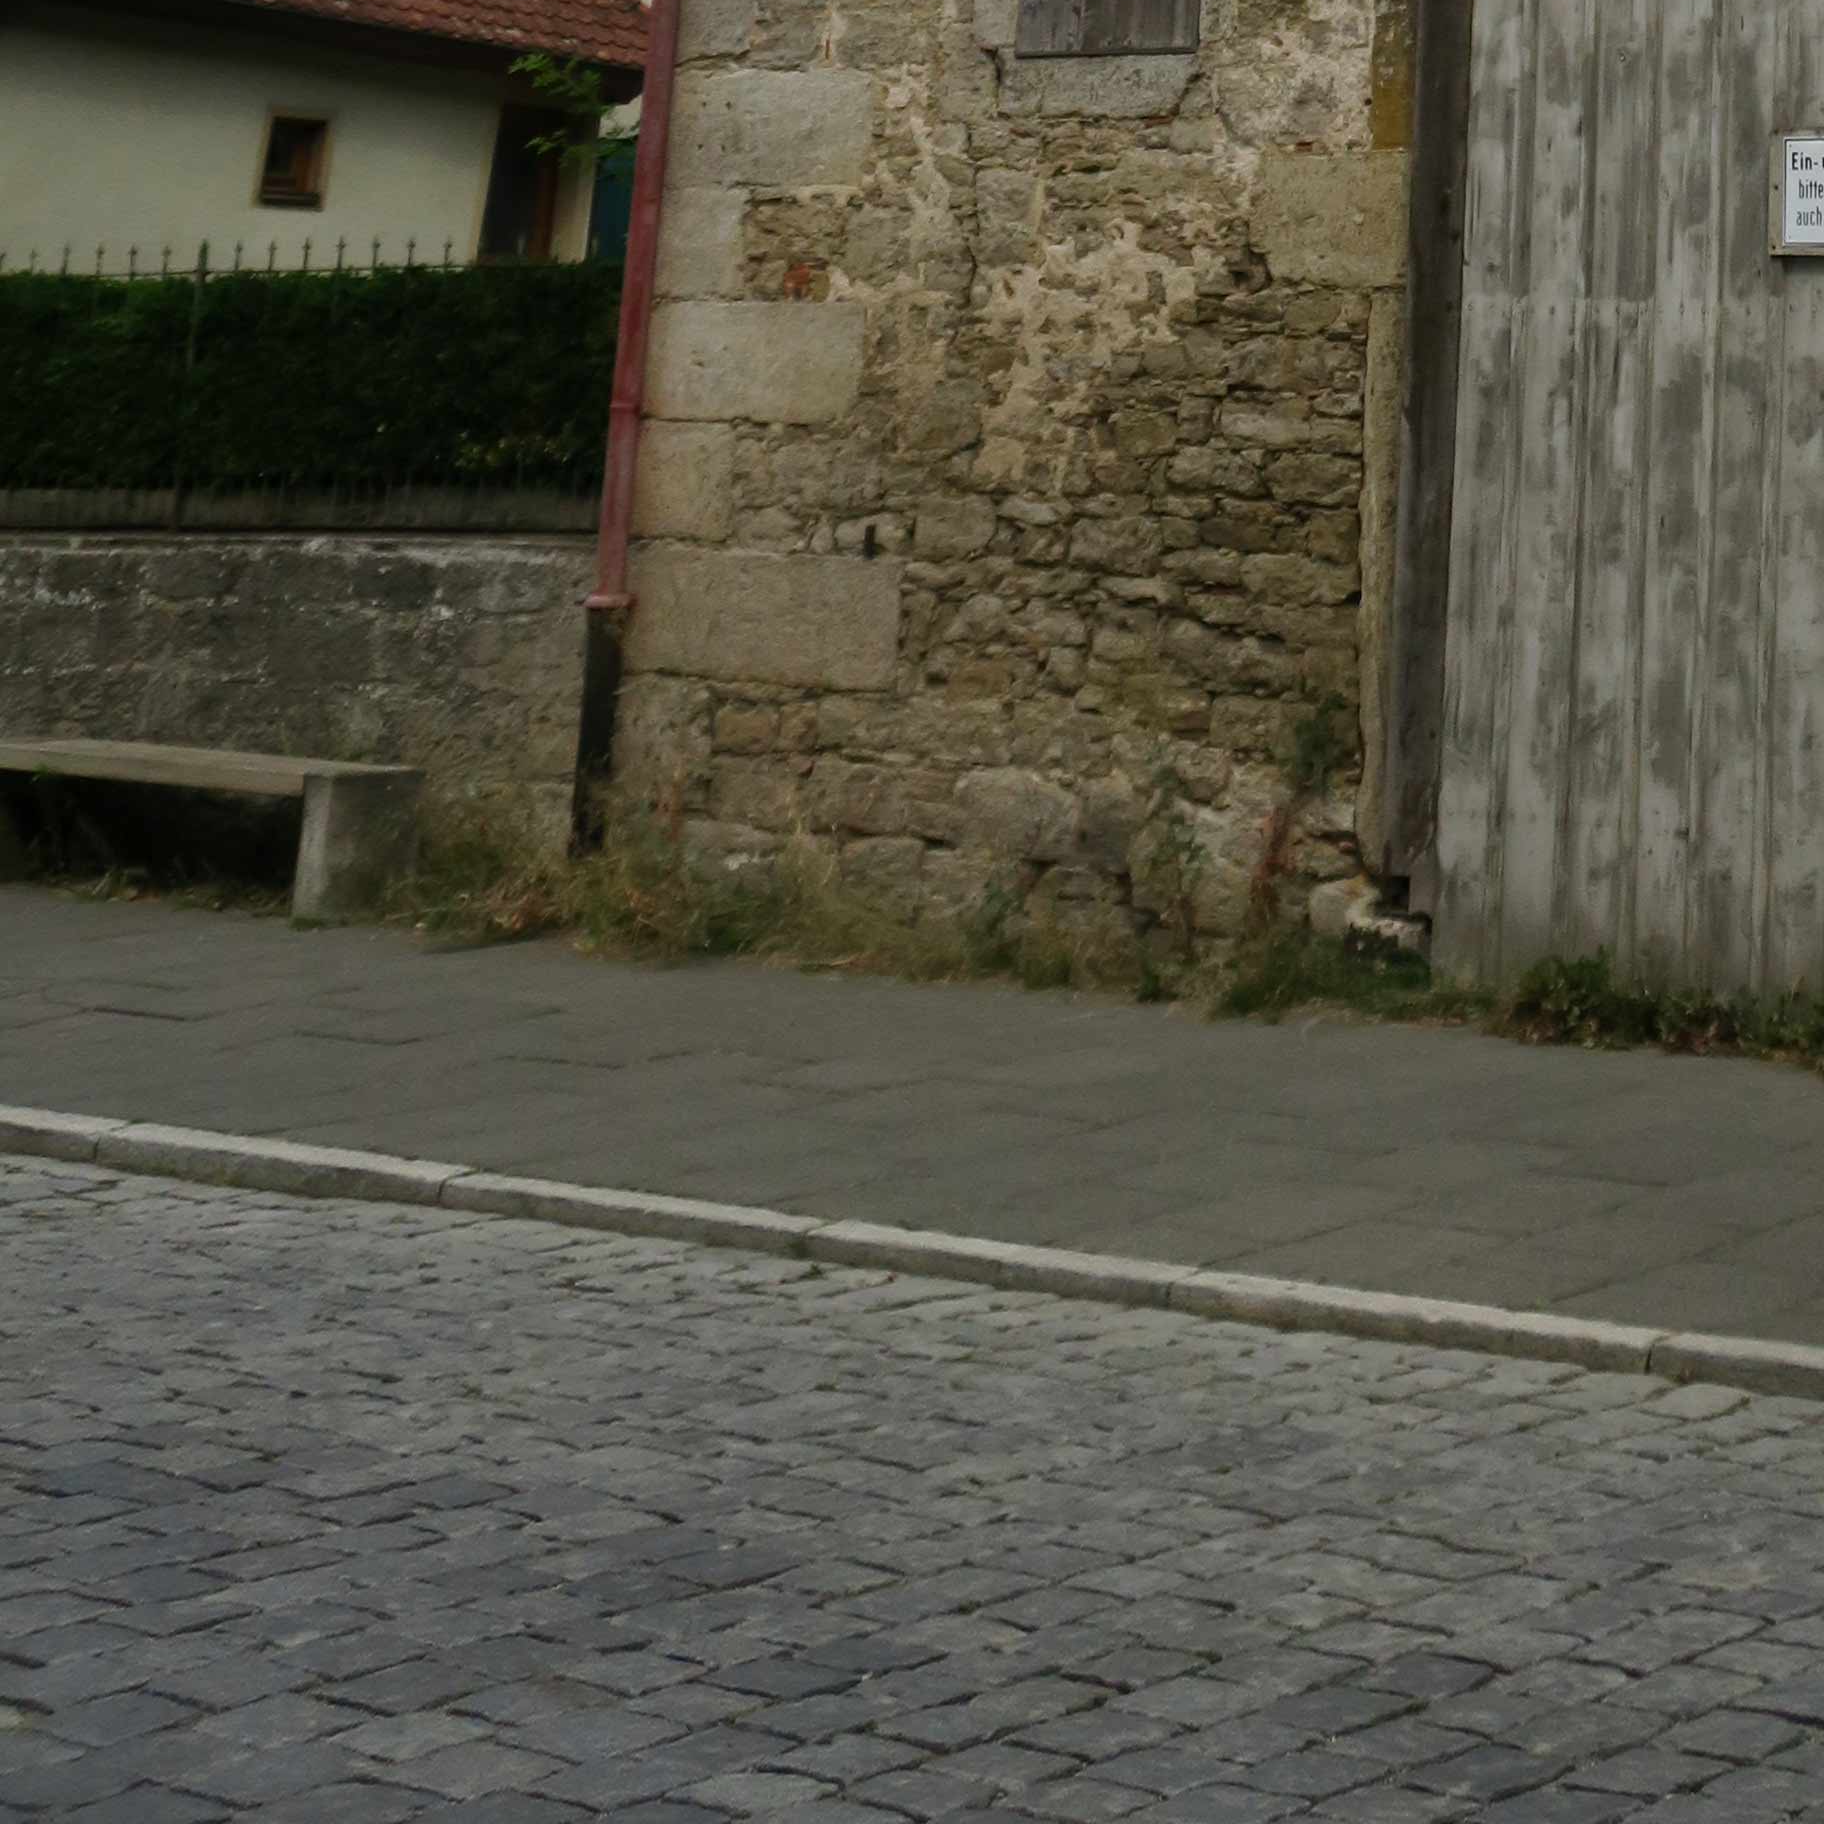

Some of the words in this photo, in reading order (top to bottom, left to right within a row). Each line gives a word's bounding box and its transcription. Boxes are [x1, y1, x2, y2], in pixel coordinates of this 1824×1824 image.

[1791, 152, 1819, 171] Ein-
[1798, 179, 1824, 199] bitte
[1796, 206, 1822, 226] auch
